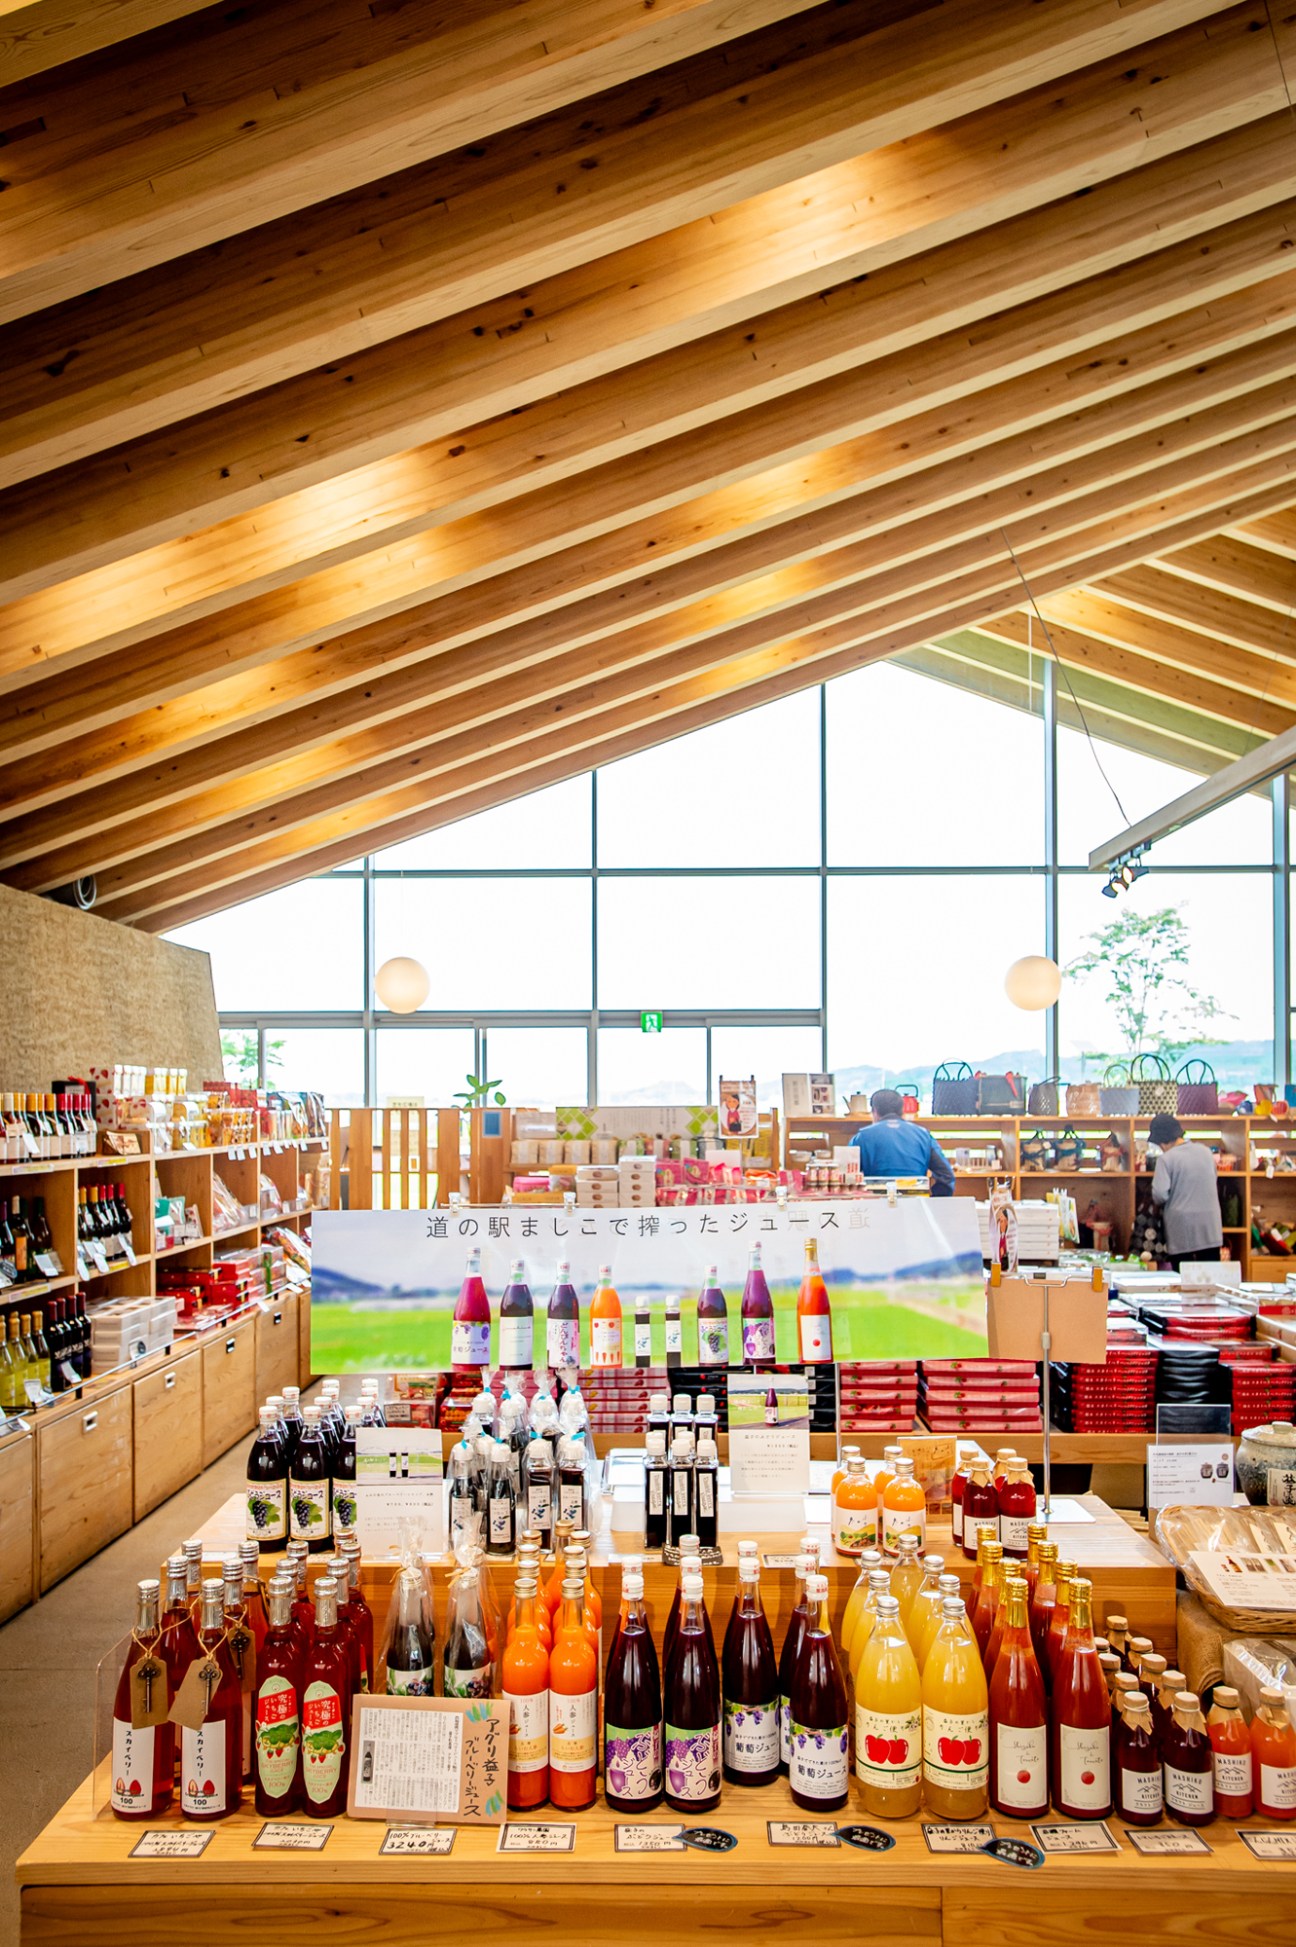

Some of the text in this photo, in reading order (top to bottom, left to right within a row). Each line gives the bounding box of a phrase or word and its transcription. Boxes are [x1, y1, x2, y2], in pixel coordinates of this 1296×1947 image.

[427, 1211, 840, 1239] 道の駅ましこで搾ったジュース
[270, 1698, 278, 1719] いちご
[278, 1694, 287, 1719] 究極の
[321, 1701, 331, 1725] 究極の
[124, 1730, 132, 1776] スカイベリー
[482, 1718, 501, 1786] アグリ益子
[1217, 1758, 1246, 1766] MASHIKO
[463, 1736, 481, 1817] ブルーベリージュース
[797, 1764, 847, 1778] 葡萄ジュース
[1172, 1774, 1202, 1785] MASHIKO
[1176, 1791, 1199, 1799] KITCHEN
